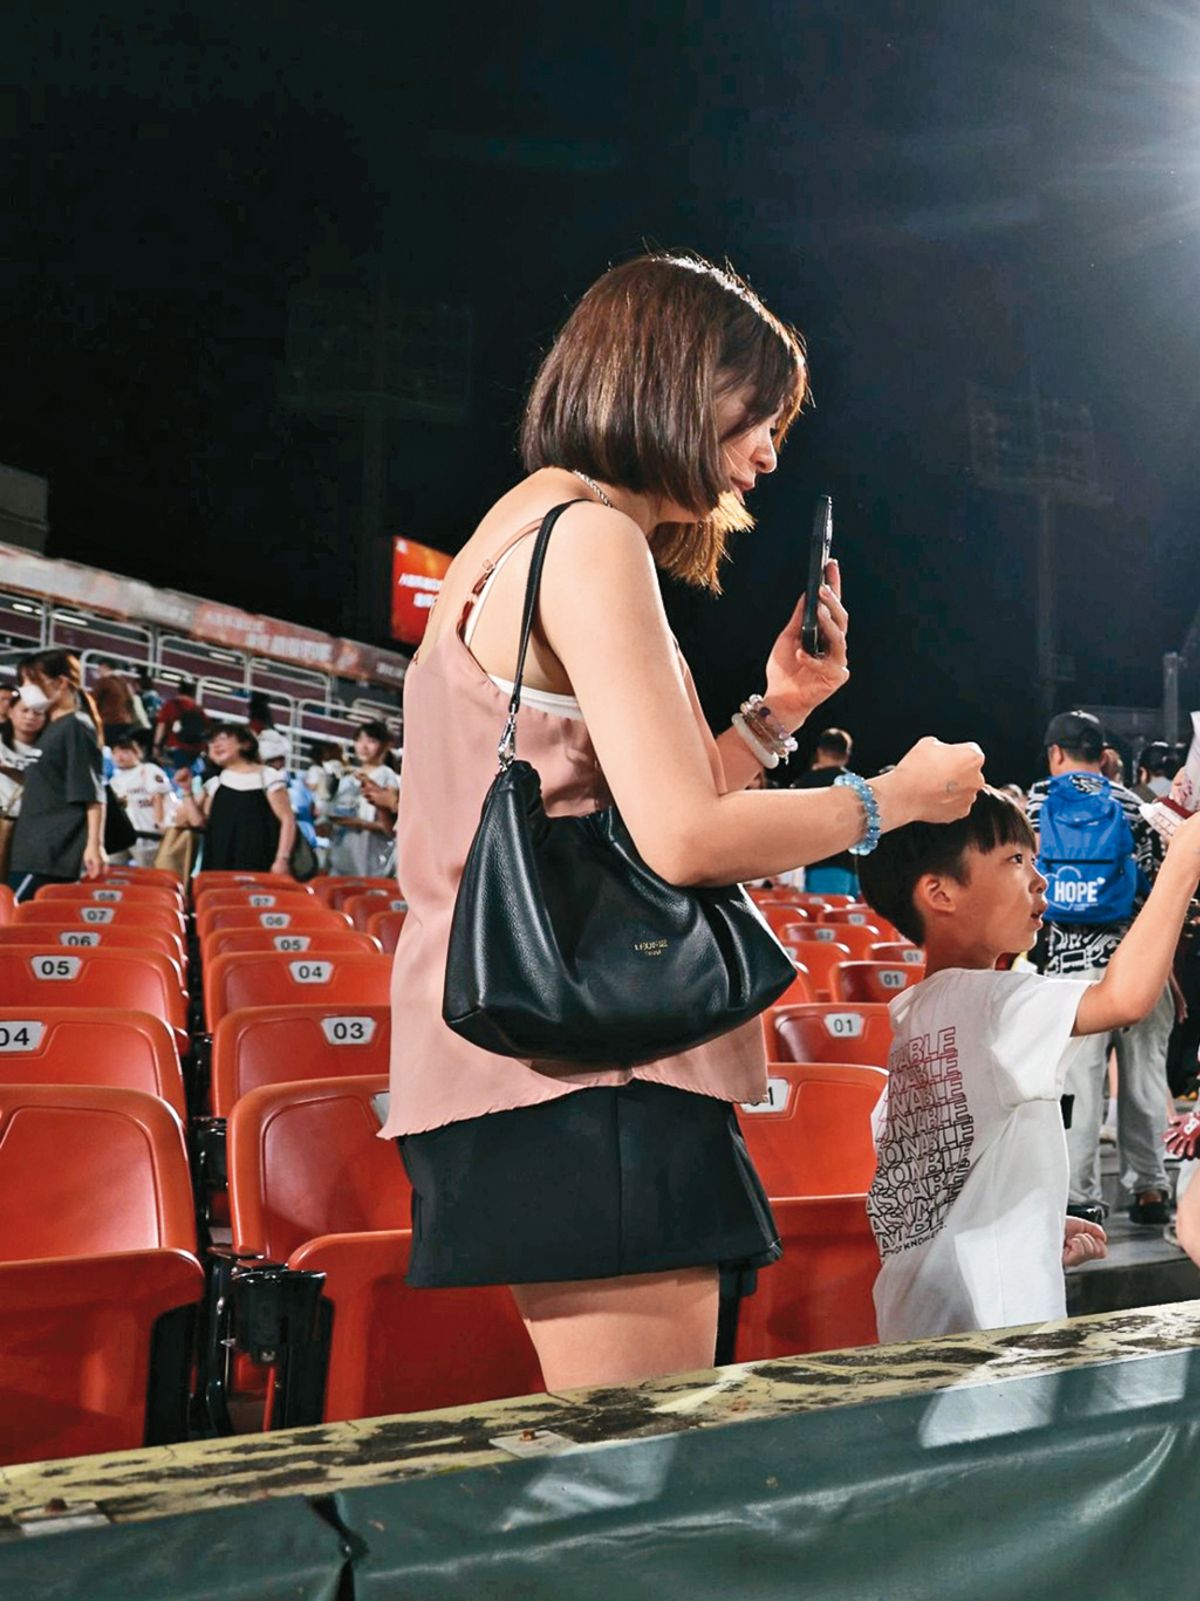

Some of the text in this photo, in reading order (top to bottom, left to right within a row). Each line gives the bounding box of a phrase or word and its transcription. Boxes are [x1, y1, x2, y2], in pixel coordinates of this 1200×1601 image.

[1054, 880, 1098, 903] HOPE
[87, 911, 106, 921] 07
[68, 935, 91, 946] 06
[41, 960, 70, 976] 05
[299, 965, 322, 979] 04
[883, 973, 899, 985] 01
[333, 1023, 364, 1039] 03
[834, 1019, 853, 1033] 01
